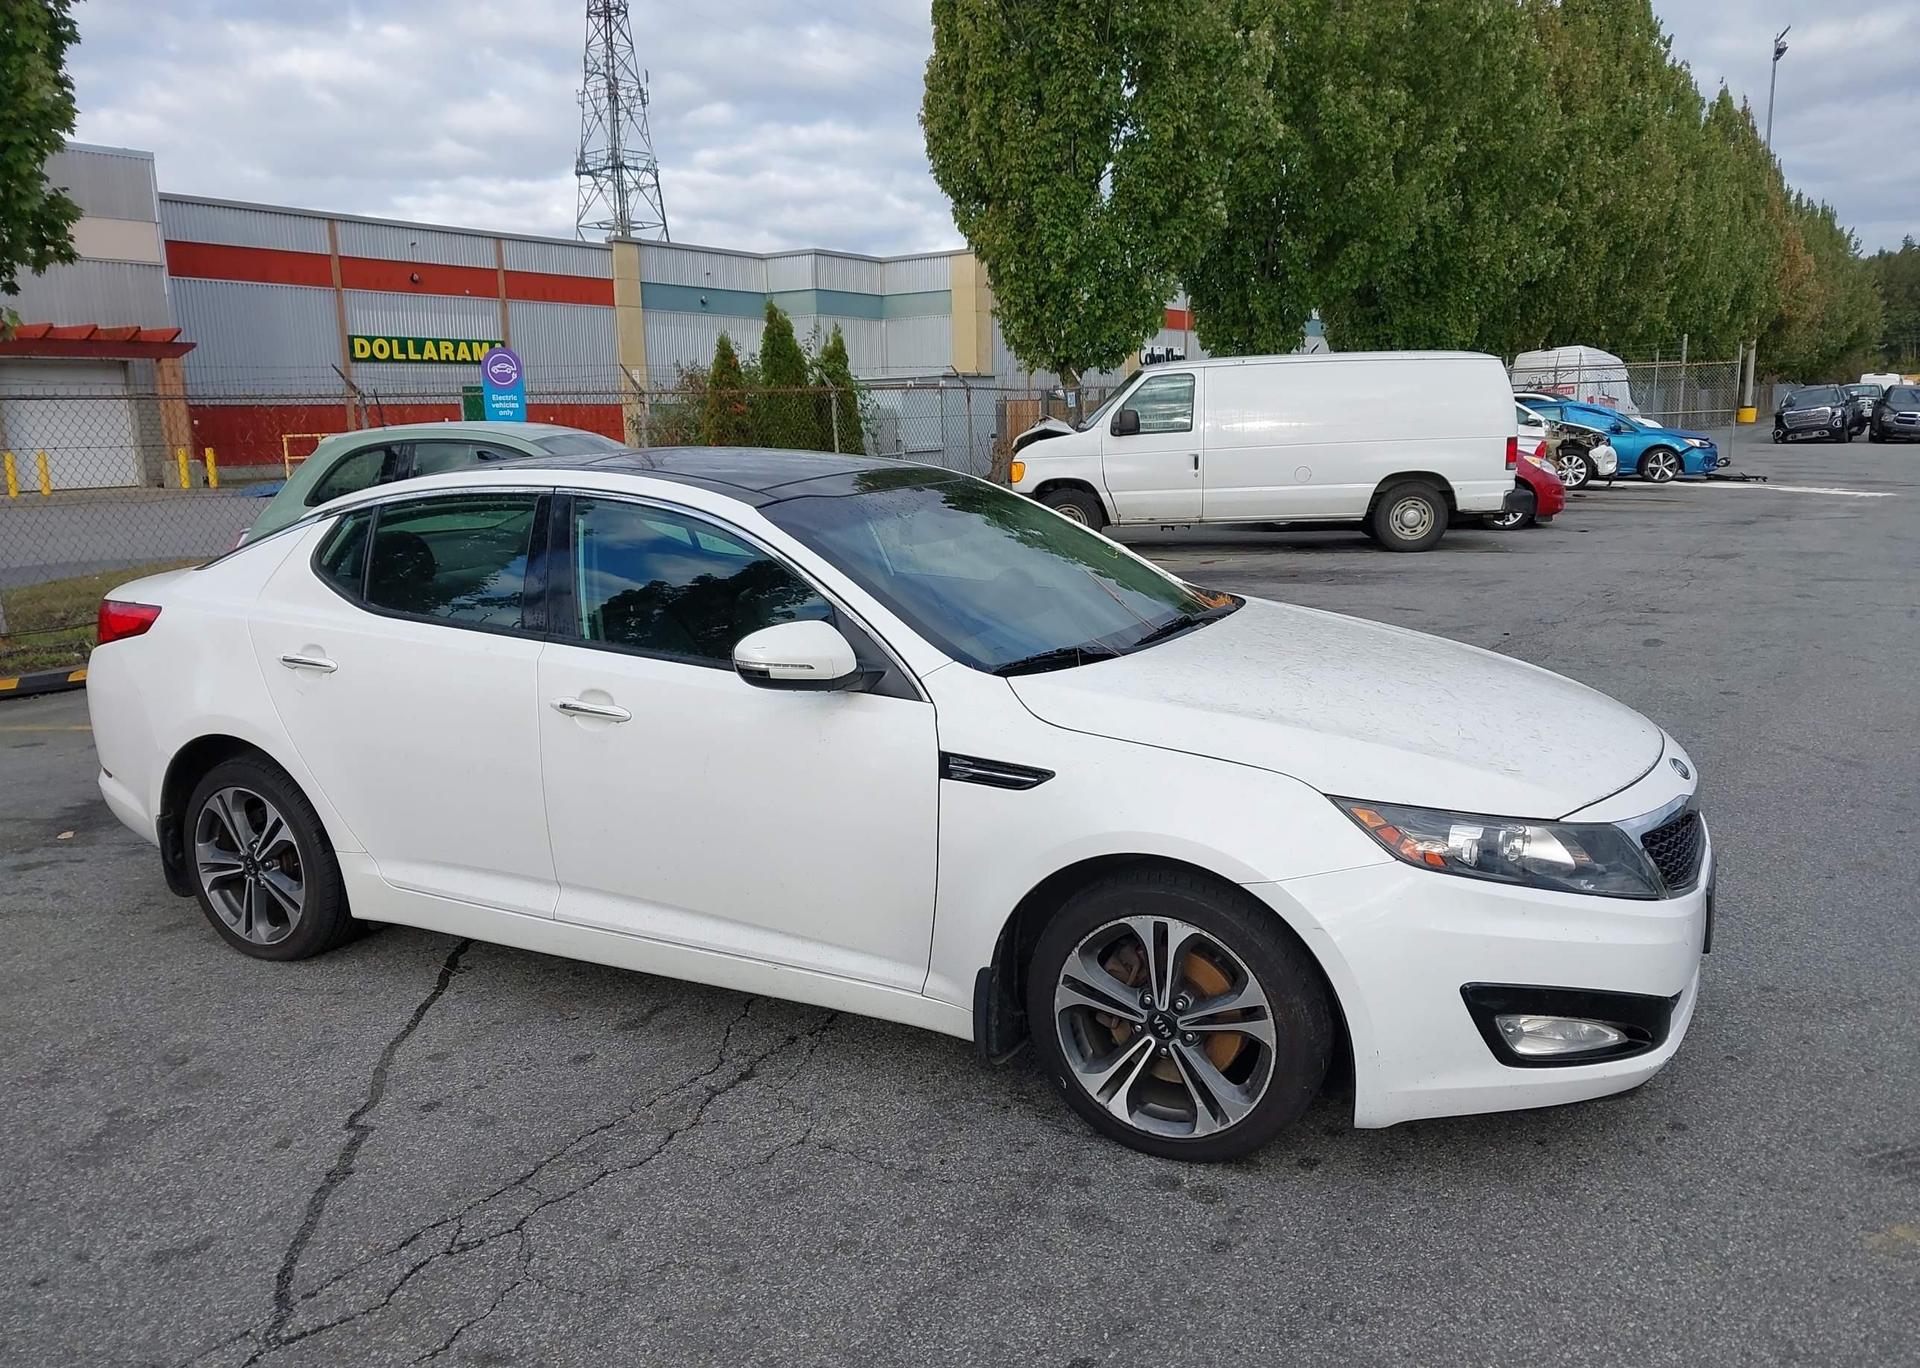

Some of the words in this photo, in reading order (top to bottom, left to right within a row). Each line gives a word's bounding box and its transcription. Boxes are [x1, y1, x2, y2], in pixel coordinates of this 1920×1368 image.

[353, 337, 502, 362] DOLLARAM
[498, 409, 514, 417] only
[1153, 1014, 1172, 1038] KIA
